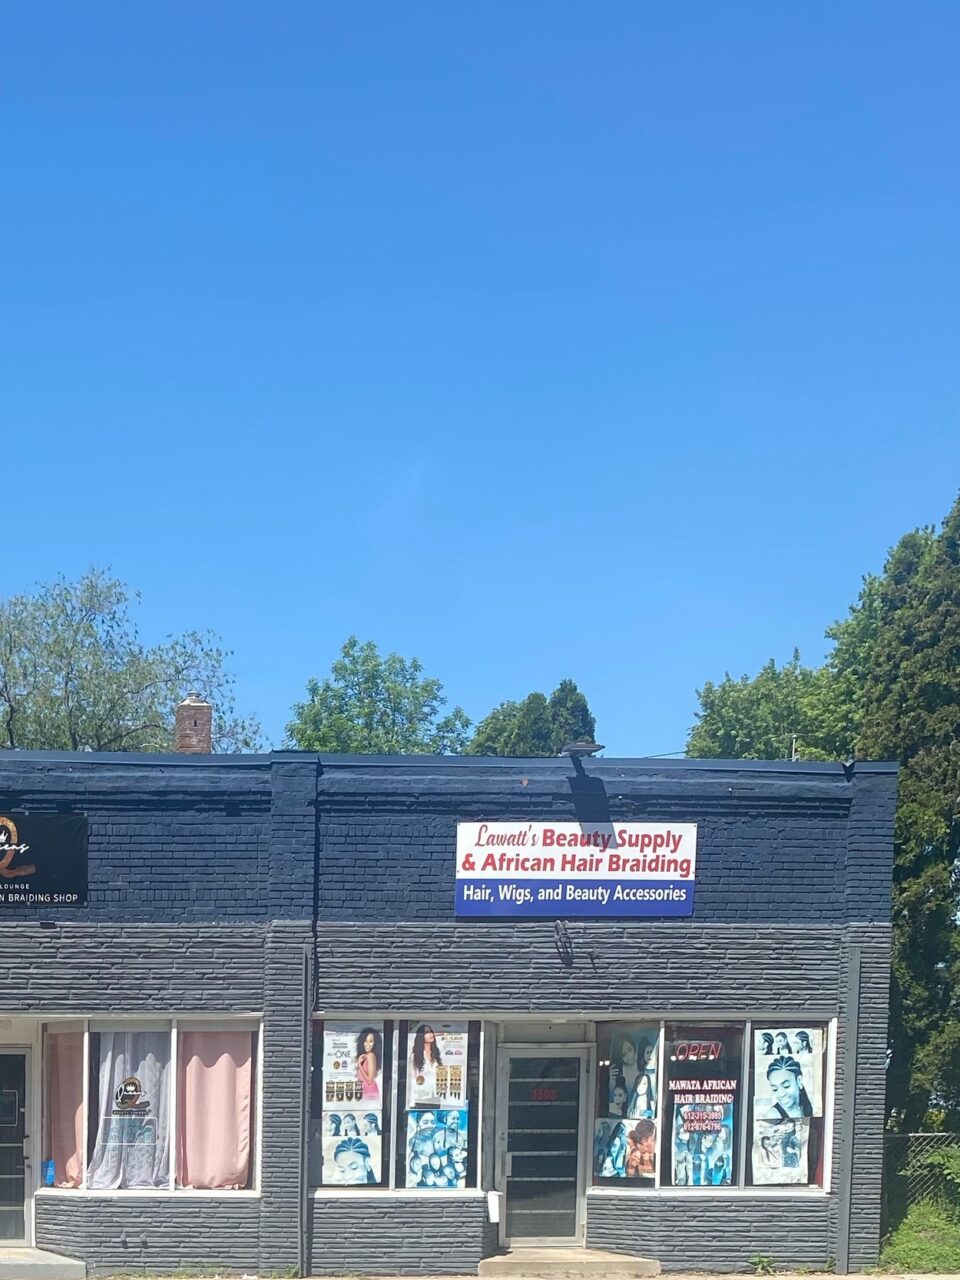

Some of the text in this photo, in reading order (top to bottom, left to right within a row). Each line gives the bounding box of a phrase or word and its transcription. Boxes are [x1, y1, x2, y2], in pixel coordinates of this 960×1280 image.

[474, 824, 683, 853] Lawatt's Beauty Supply
[461, 852, 692, 878] & African Hair Braiding
[8, 893, 50, 902] BRAIDING
[53, 893, 78, 902] SHOP
[463, 884, 687, 905] Hair, Wigs, and Beauty Accessories
[676, 1043, 722, 1060] OPEN
[668, 1080, 737, 1090] MAWATA AFRICAN
[673, 1093, 734, 1104] HAIR BRAIDING
